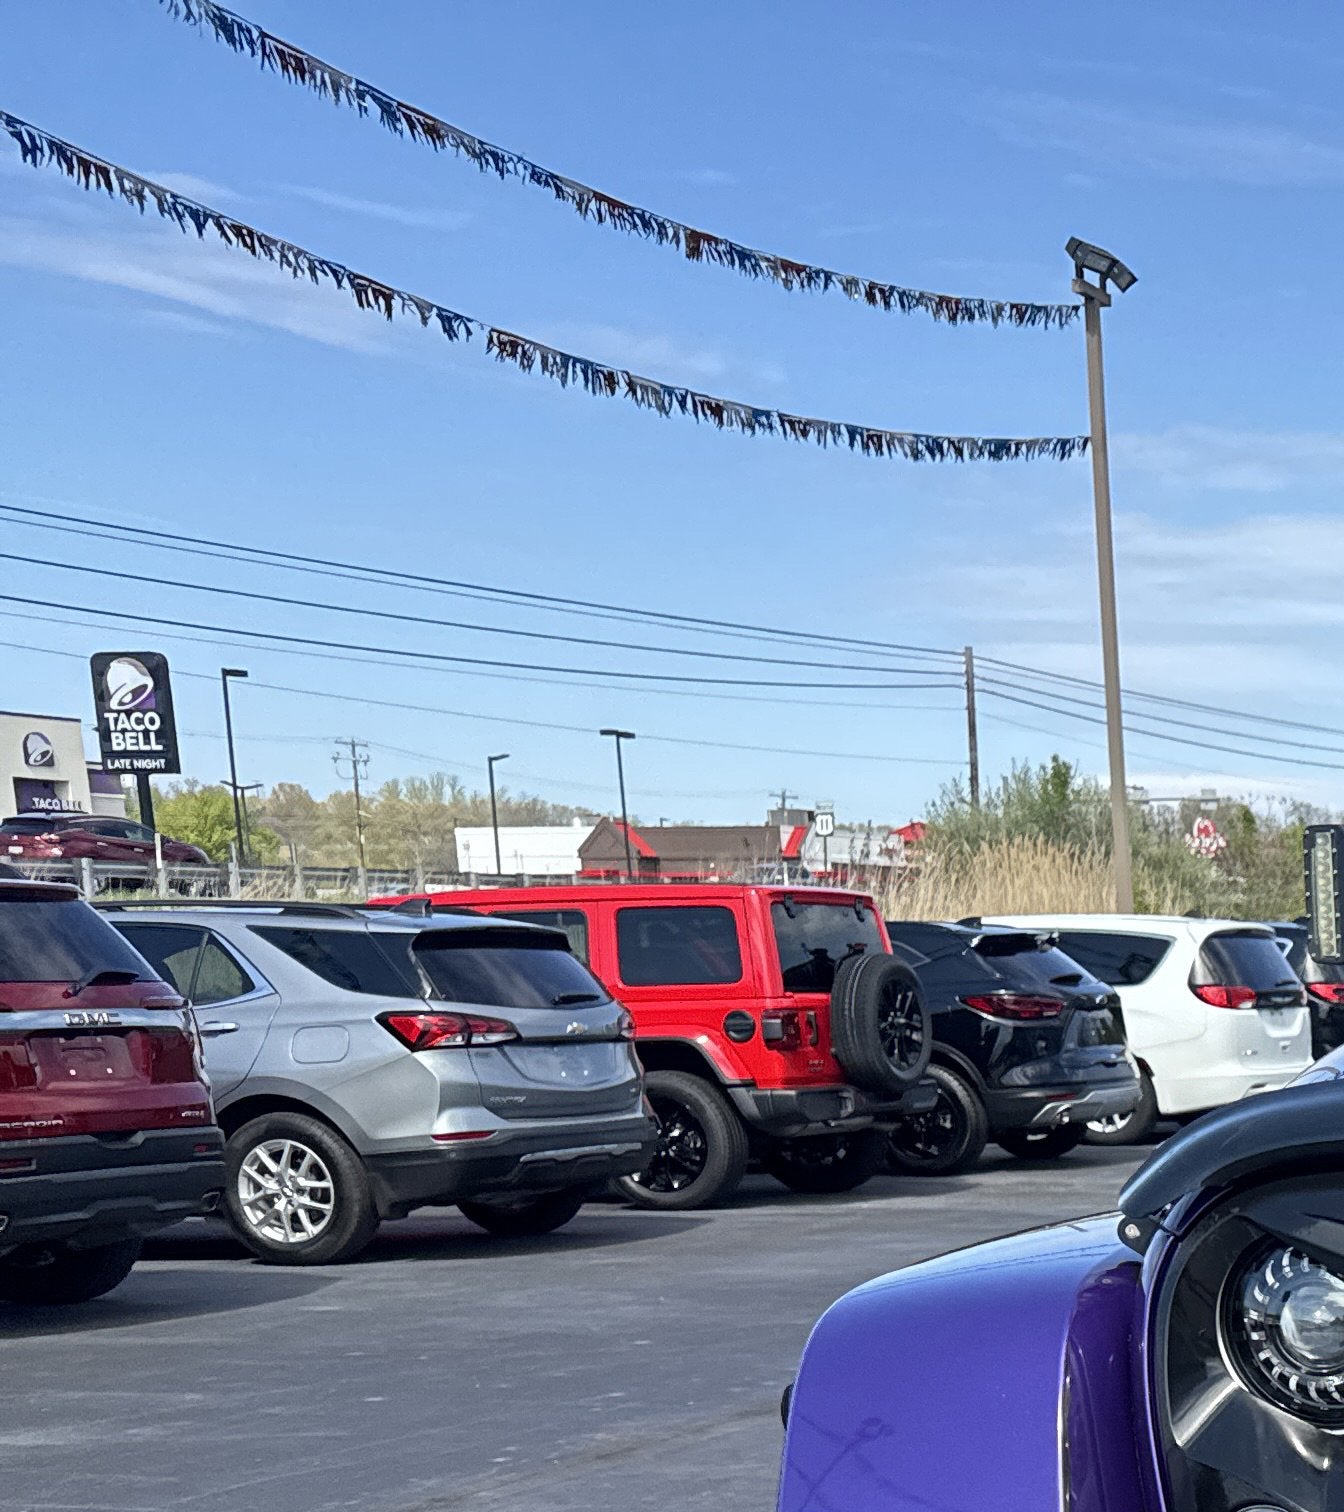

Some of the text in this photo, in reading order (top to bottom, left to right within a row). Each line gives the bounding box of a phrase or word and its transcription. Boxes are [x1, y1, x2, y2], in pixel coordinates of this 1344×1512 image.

[103, 711, 161, 732] TACO
[110, 731, 164, 751] BELL
[107, 758, 166, 770] LATE NIGHT
[32, 797, 60, 810] TACO
[820, 818, 829, 831] 11
